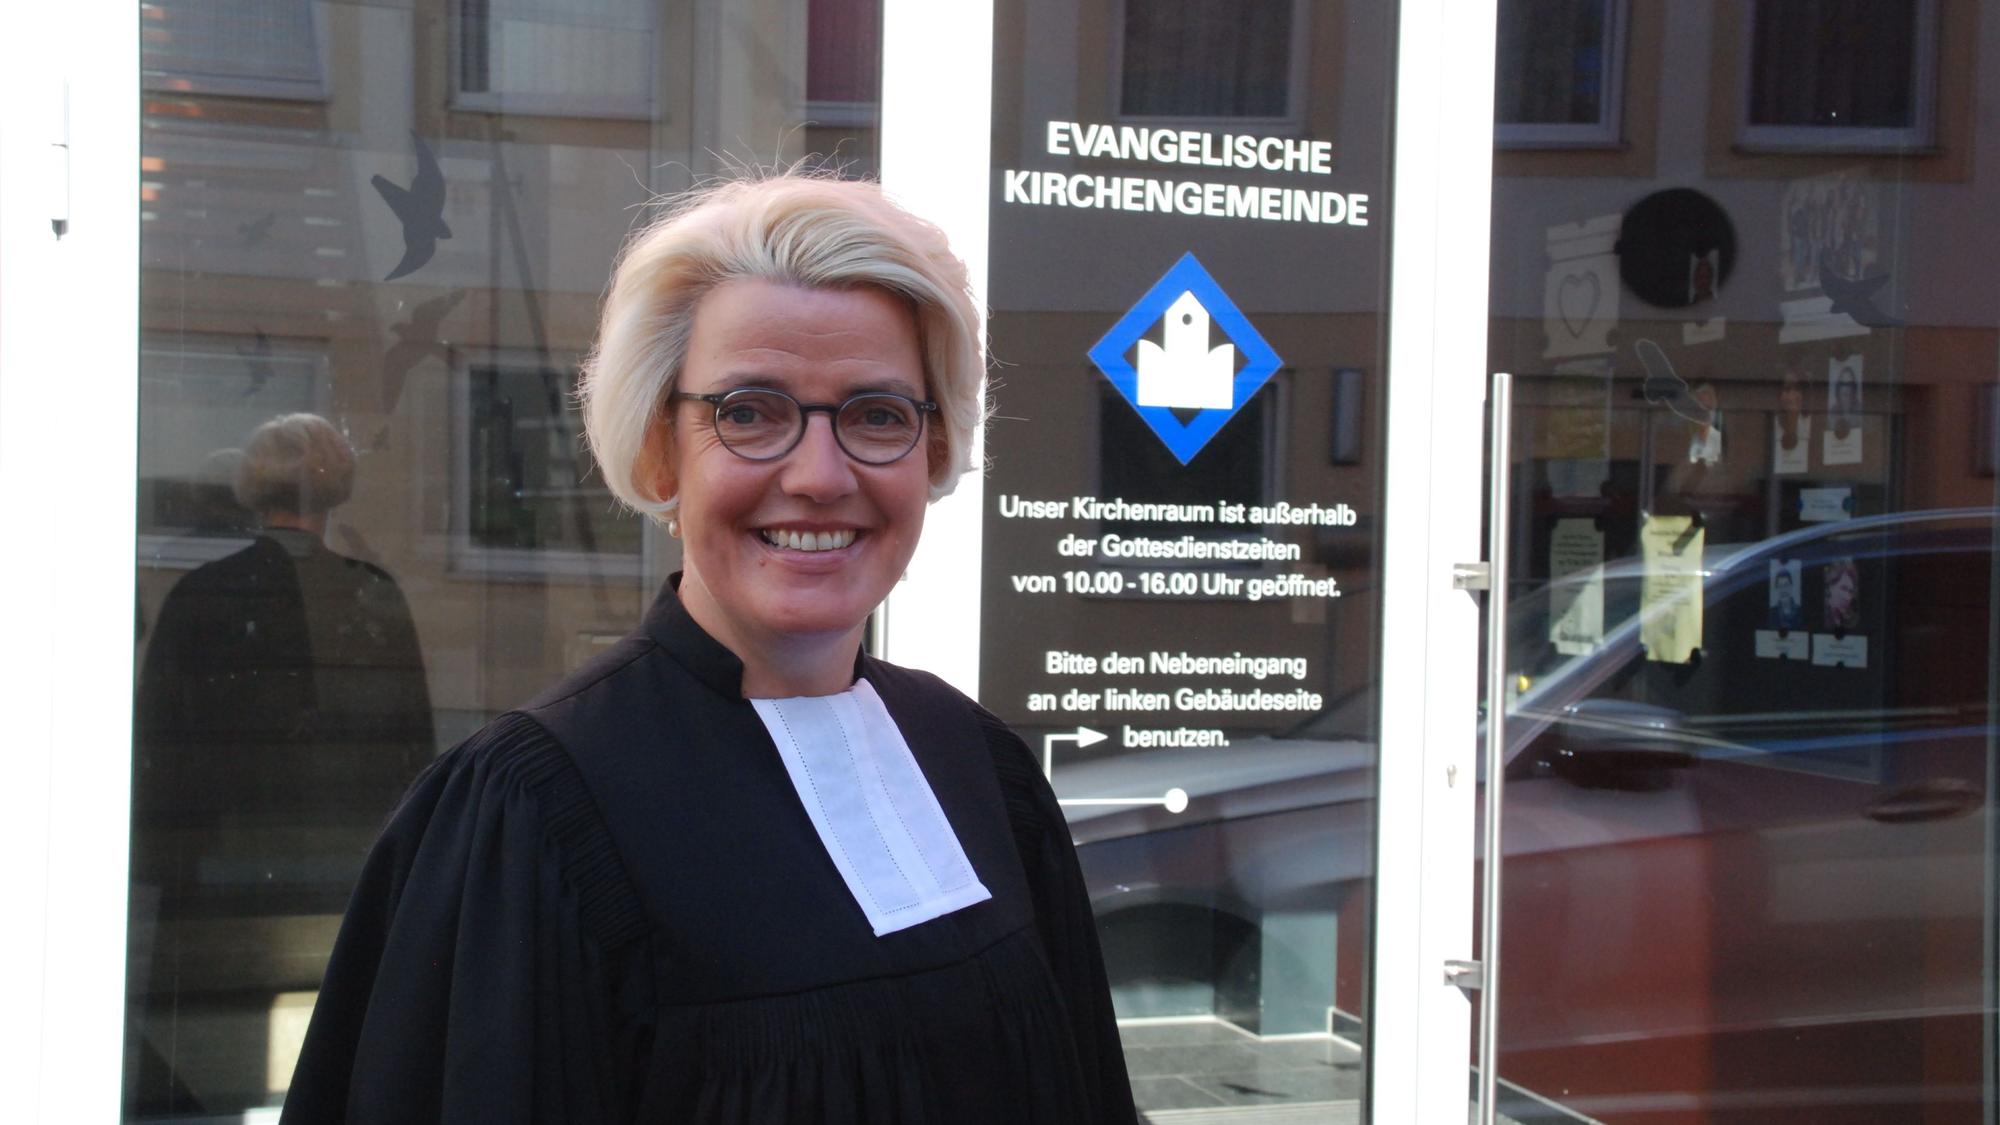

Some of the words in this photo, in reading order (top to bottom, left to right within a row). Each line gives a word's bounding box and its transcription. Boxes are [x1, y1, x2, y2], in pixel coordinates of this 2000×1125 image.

[1047, 121, 1332, 174] EVANGELISCHE
[1005, 170, 1368, 226] KIRCHENGEMEINDE
[1000, 495, 1068, 518] Unser
[1073, 497, 1214, 521] Kirchenraum
[1220, 501, 1245, 523] ist
[1250, 502, 1356, 525] außerhalb
[1058, 534, 1097, 556] der
[1102, 534, 1300, 560] Gottesdienstzeiten
[1012, 576, 1056, 592] von
[1064, 571, 1123, 593] 10.00
[1140, 573, 1197, 594] 16.00
[1203, 573, 1243, 595] Uhr
[1248, 574, 1340, 600] geöffnet.
[1047, 651, 1097, 674] Bitte
[1102, 652, 1144, 674] den
[1151, 652, 1306, 679] Nebeneingang
[1028, 694, 1056, 711] an
[1062, 689, 1100, 710] der
[1106, 689, 1169, 710] linken
[1175, 688, 1322, 710] Gebäudeseite
[1124, 725, 1229, 747] benutzen.
